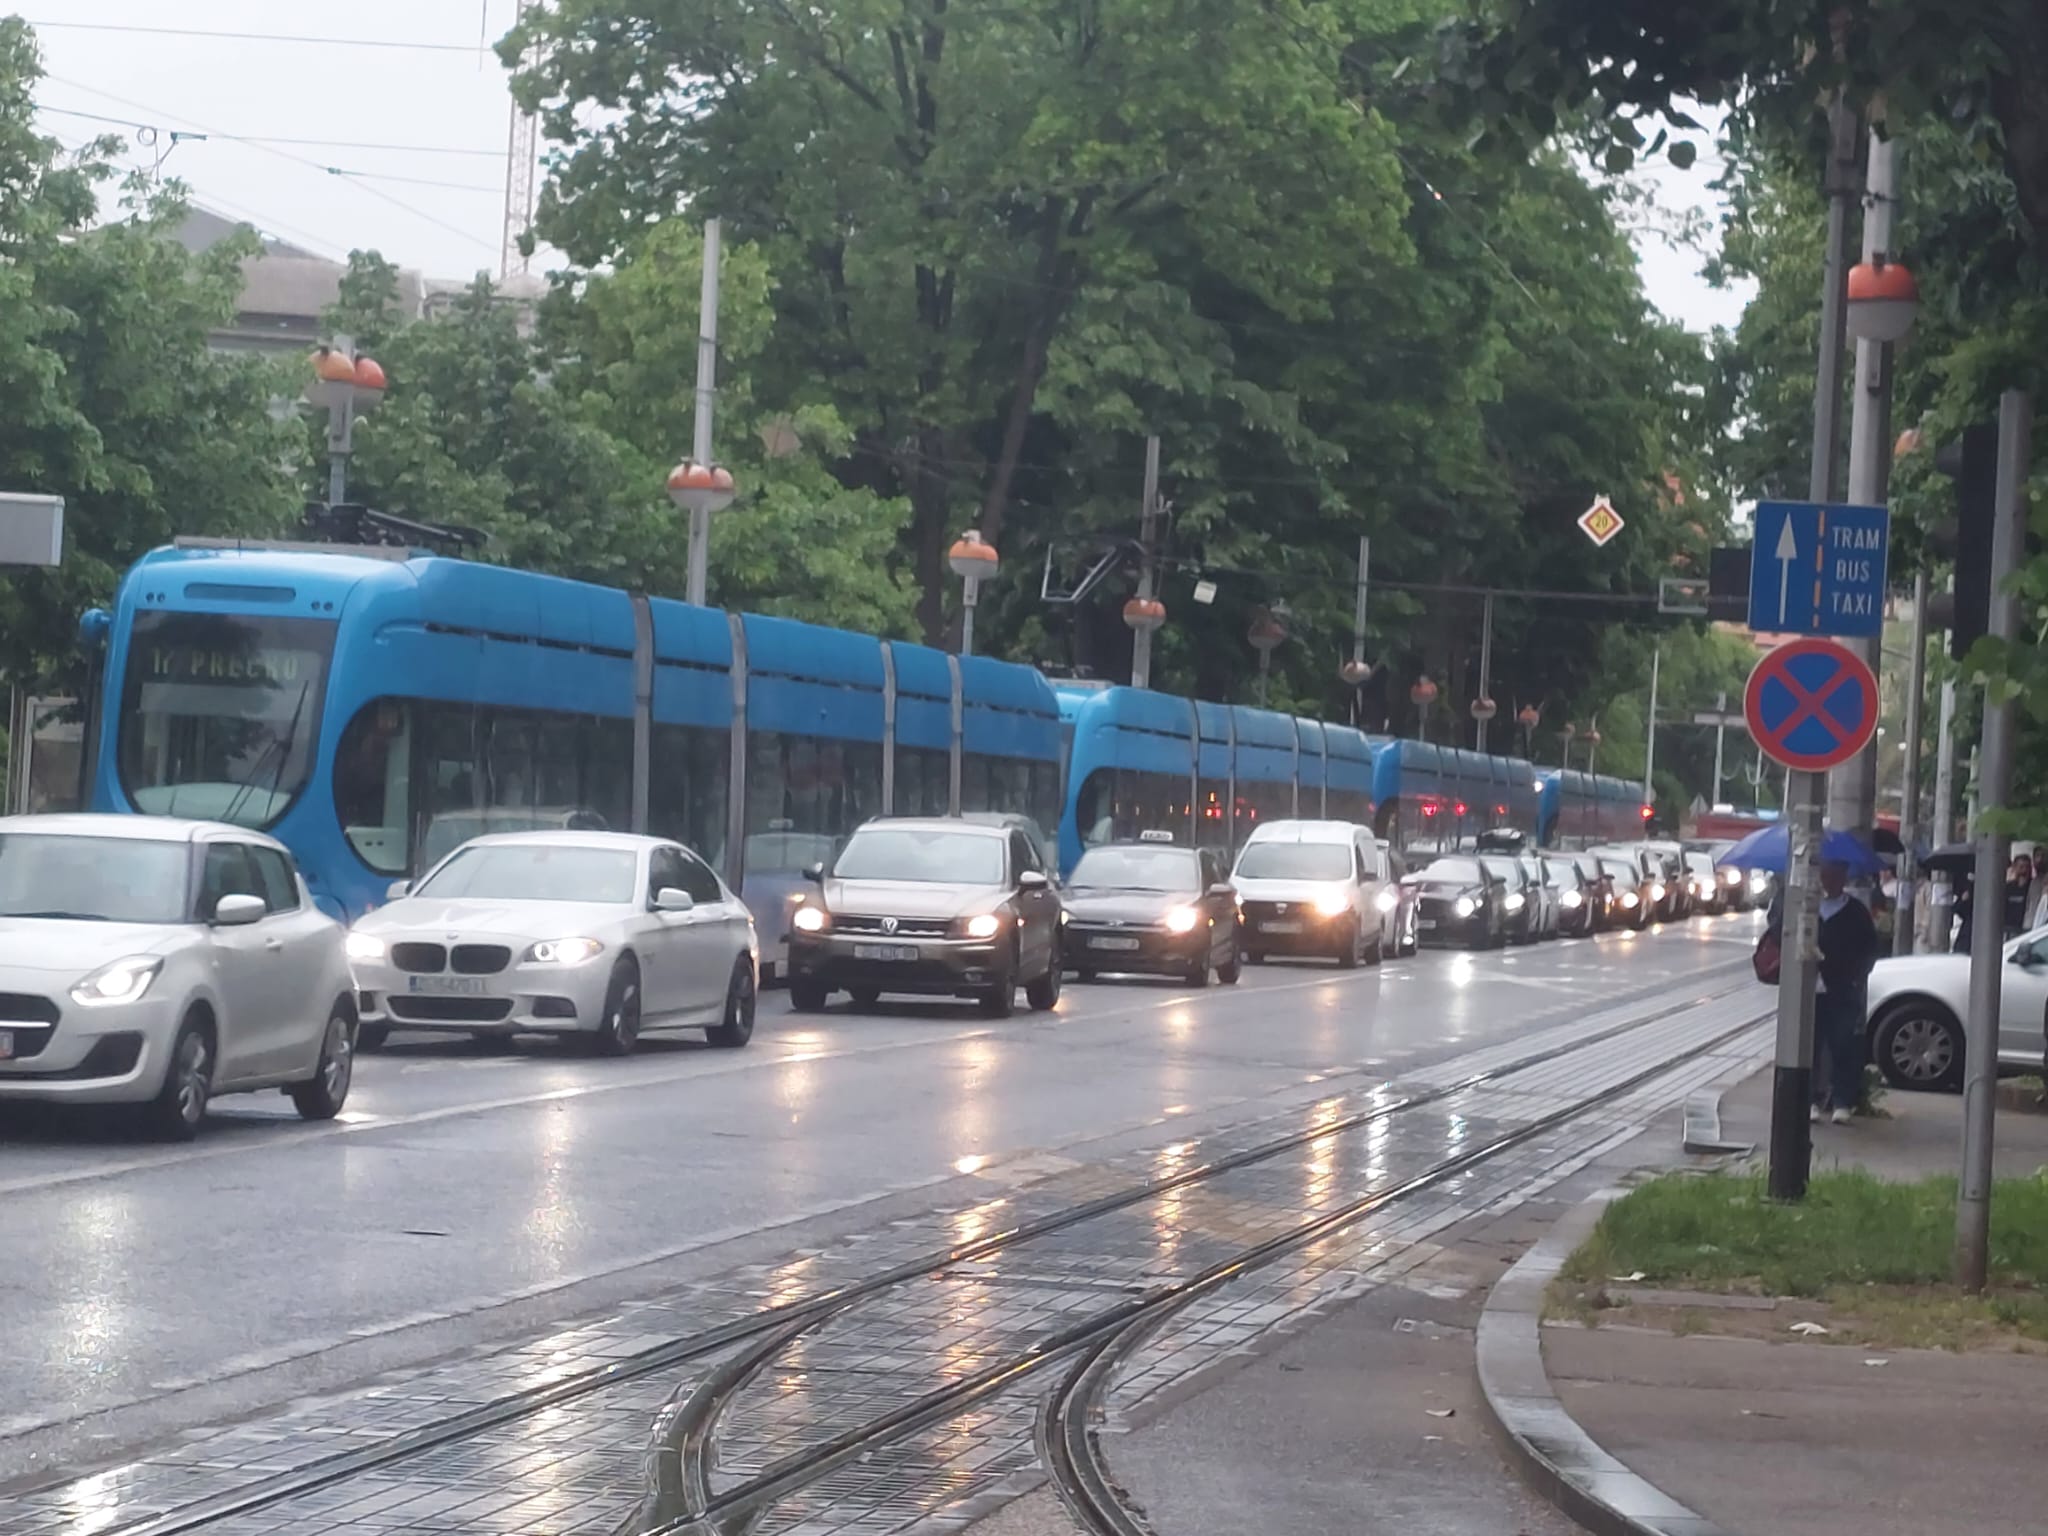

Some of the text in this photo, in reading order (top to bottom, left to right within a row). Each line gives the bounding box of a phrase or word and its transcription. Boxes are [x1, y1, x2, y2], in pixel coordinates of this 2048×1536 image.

[1595, 515, 1608, 529] 20
[1832, 526, 1880, 550] TRAM
[1836, 559, 1871, 583] BUS
[1831, 592, 1872, 615] TAXI
